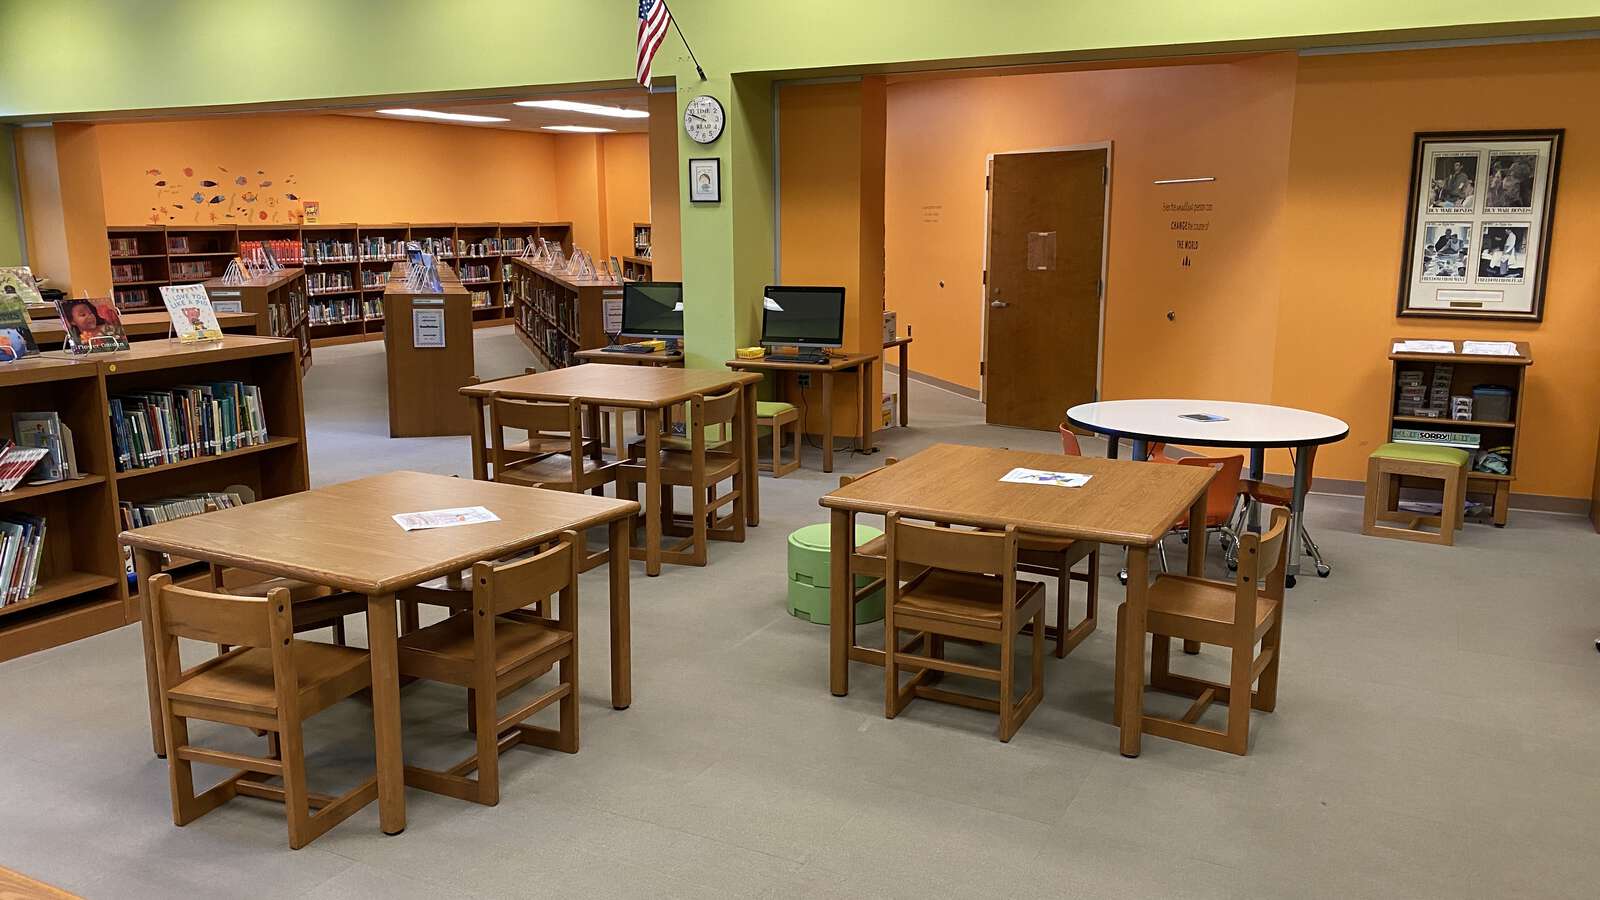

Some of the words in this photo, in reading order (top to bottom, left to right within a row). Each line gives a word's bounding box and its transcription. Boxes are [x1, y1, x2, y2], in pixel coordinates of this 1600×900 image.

[1176, 240, 1184, 249] THE
[1184, 240, 1199, 250] WORLD
[1419, 432, 1450, 440] SORRY!
